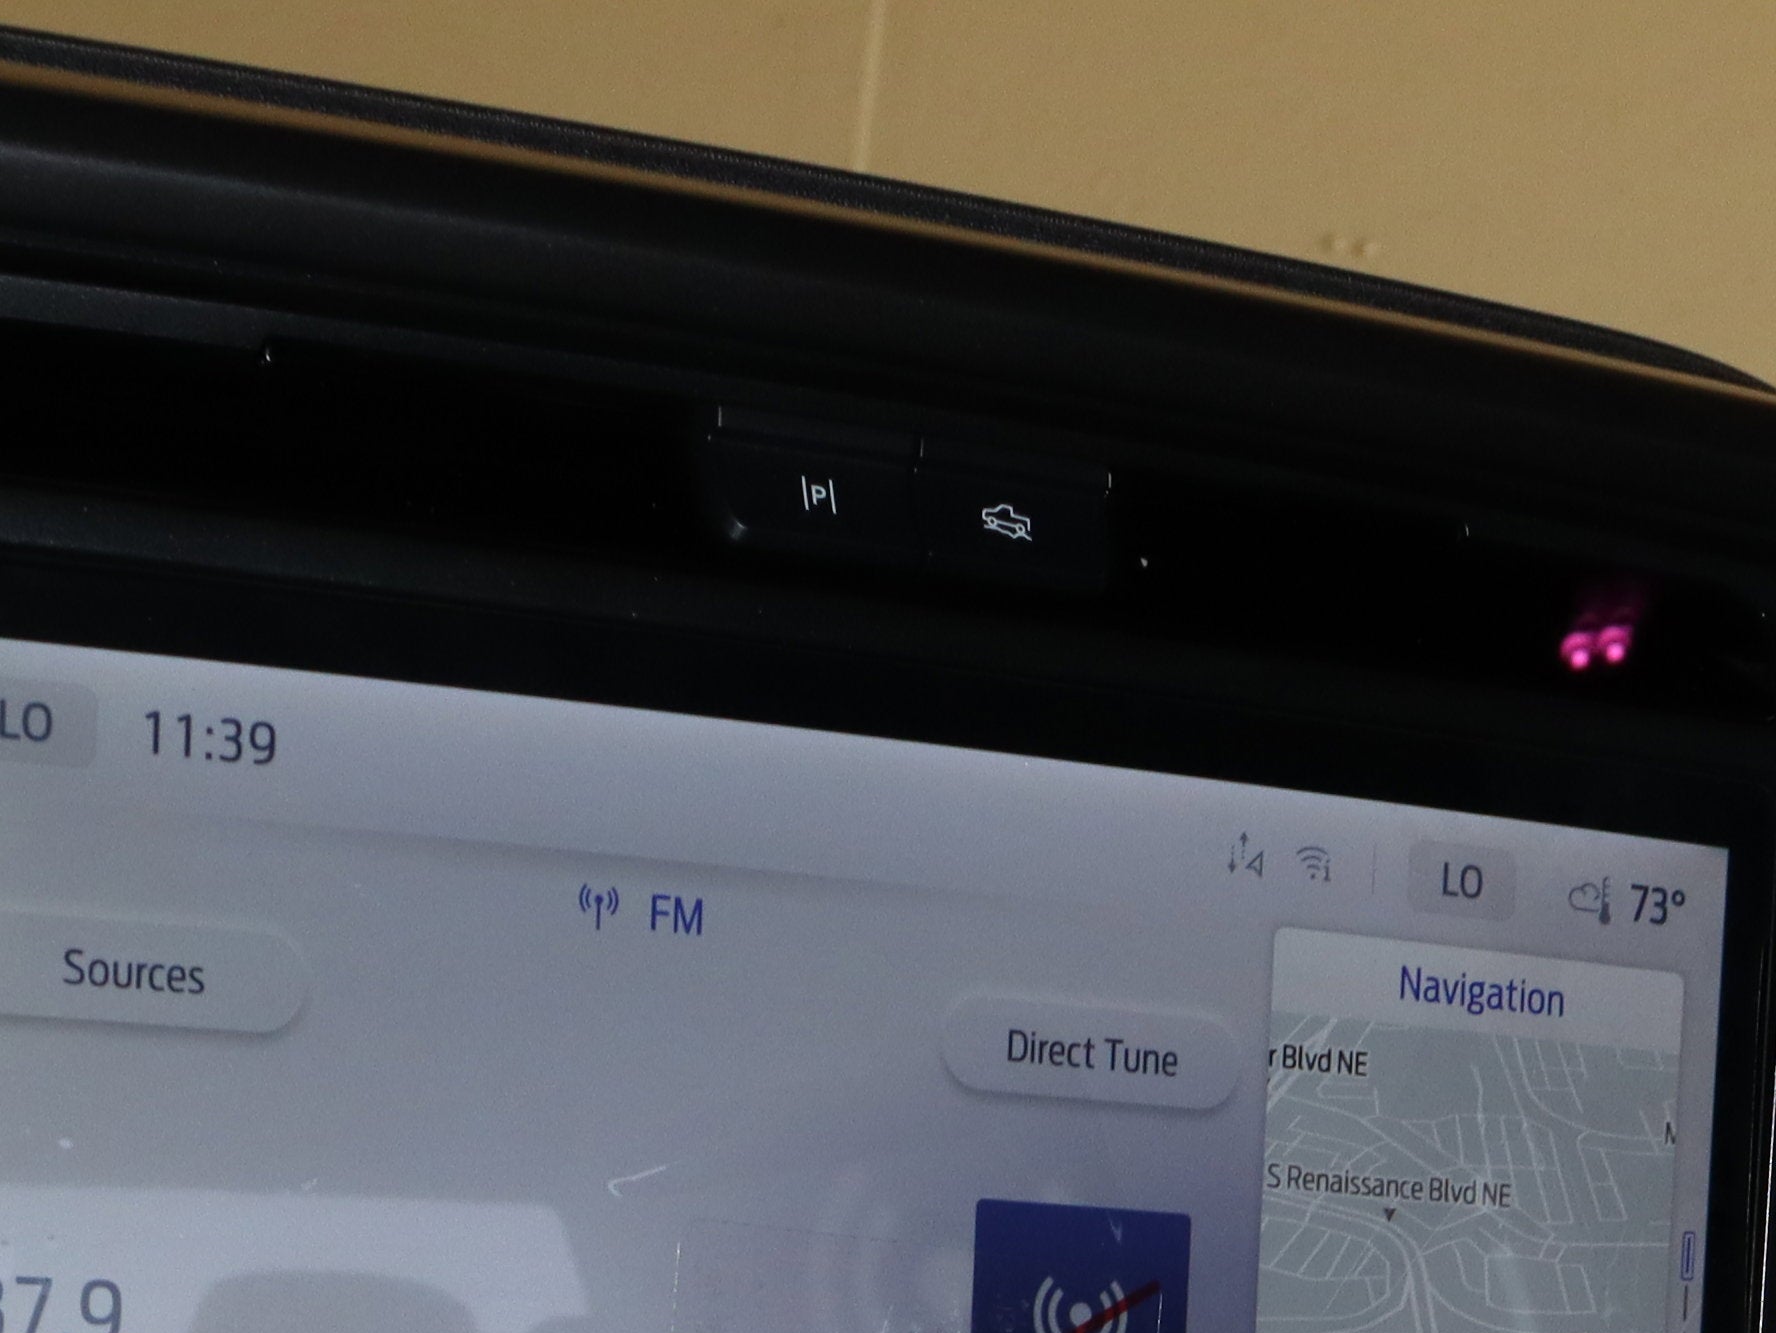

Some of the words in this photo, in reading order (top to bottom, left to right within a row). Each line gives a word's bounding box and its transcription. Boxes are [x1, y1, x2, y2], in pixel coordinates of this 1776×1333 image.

[143, 710, 278, 766] 11:39
[1441, 861, 1484, 899] LO
[649, 894, 705, 936] FM
[1629, 884, 1687, 925] 73°
[62, 948, 206, 996] Sources
[1399, 965, 1566, 1019] Navigation
[1006, 1029, 1096, 1072] Direct
[1104, 1036, 1179, 1078] Tune
[1282, 1044, 1332, 1073] Blvd
[1337, 1050, 1368, 1076] NE
[1287, 1165, 1423, 1200] Renaissance
[1429, 1176, 1478, 1205] Blvd
[1483, 1182, 1512, 1207] NE
